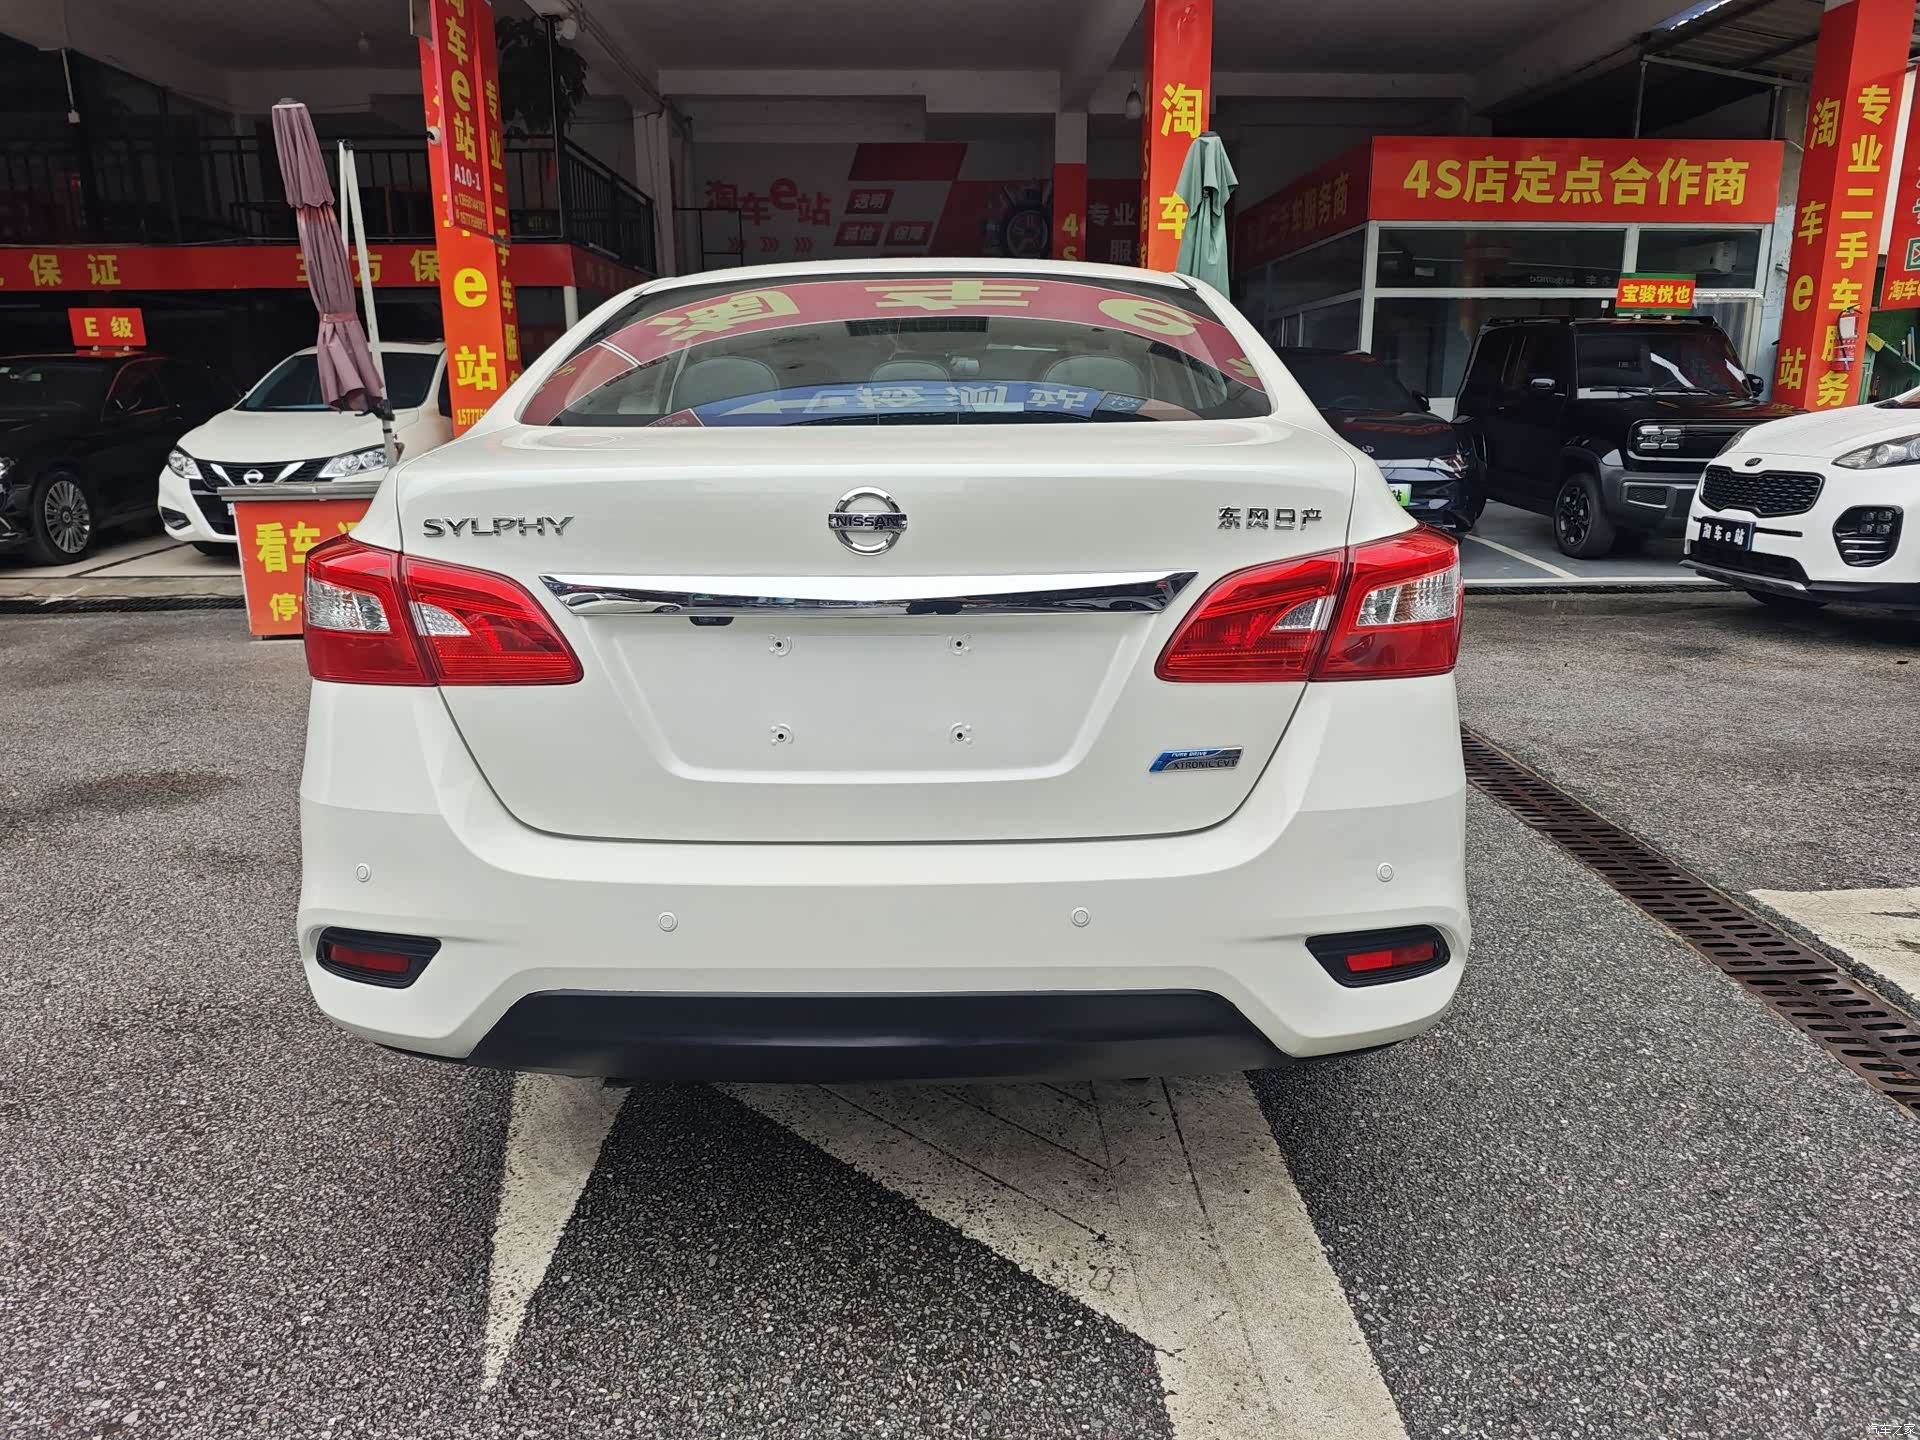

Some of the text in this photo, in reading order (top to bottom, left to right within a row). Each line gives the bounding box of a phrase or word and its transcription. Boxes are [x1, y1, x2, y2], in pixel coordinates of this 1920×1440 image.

[1157, 83, 1203, 240] 淘车
[454, 163, 482, 192] A10-1
[1403, 156, 1750, 206] 4S店定点合作商
[705, 177, 832, 227] 淘车e站
[1776, 97, 1841, 390] 淘车e站
[0, 253, 121, 287] 保证
[1621, 284, 1691, 305] 宝骏悦也
[422, 514, 575, 538] SYLPHY
[834, 514, 903, 531] NISSAN
[1217, 506, 1323, 530] 东风日产
[1702, 522, 1745, 546] 淘车e站
[269, 593, 303, 622] 停
[1174, 760, 1215, 770] XTRONIC
